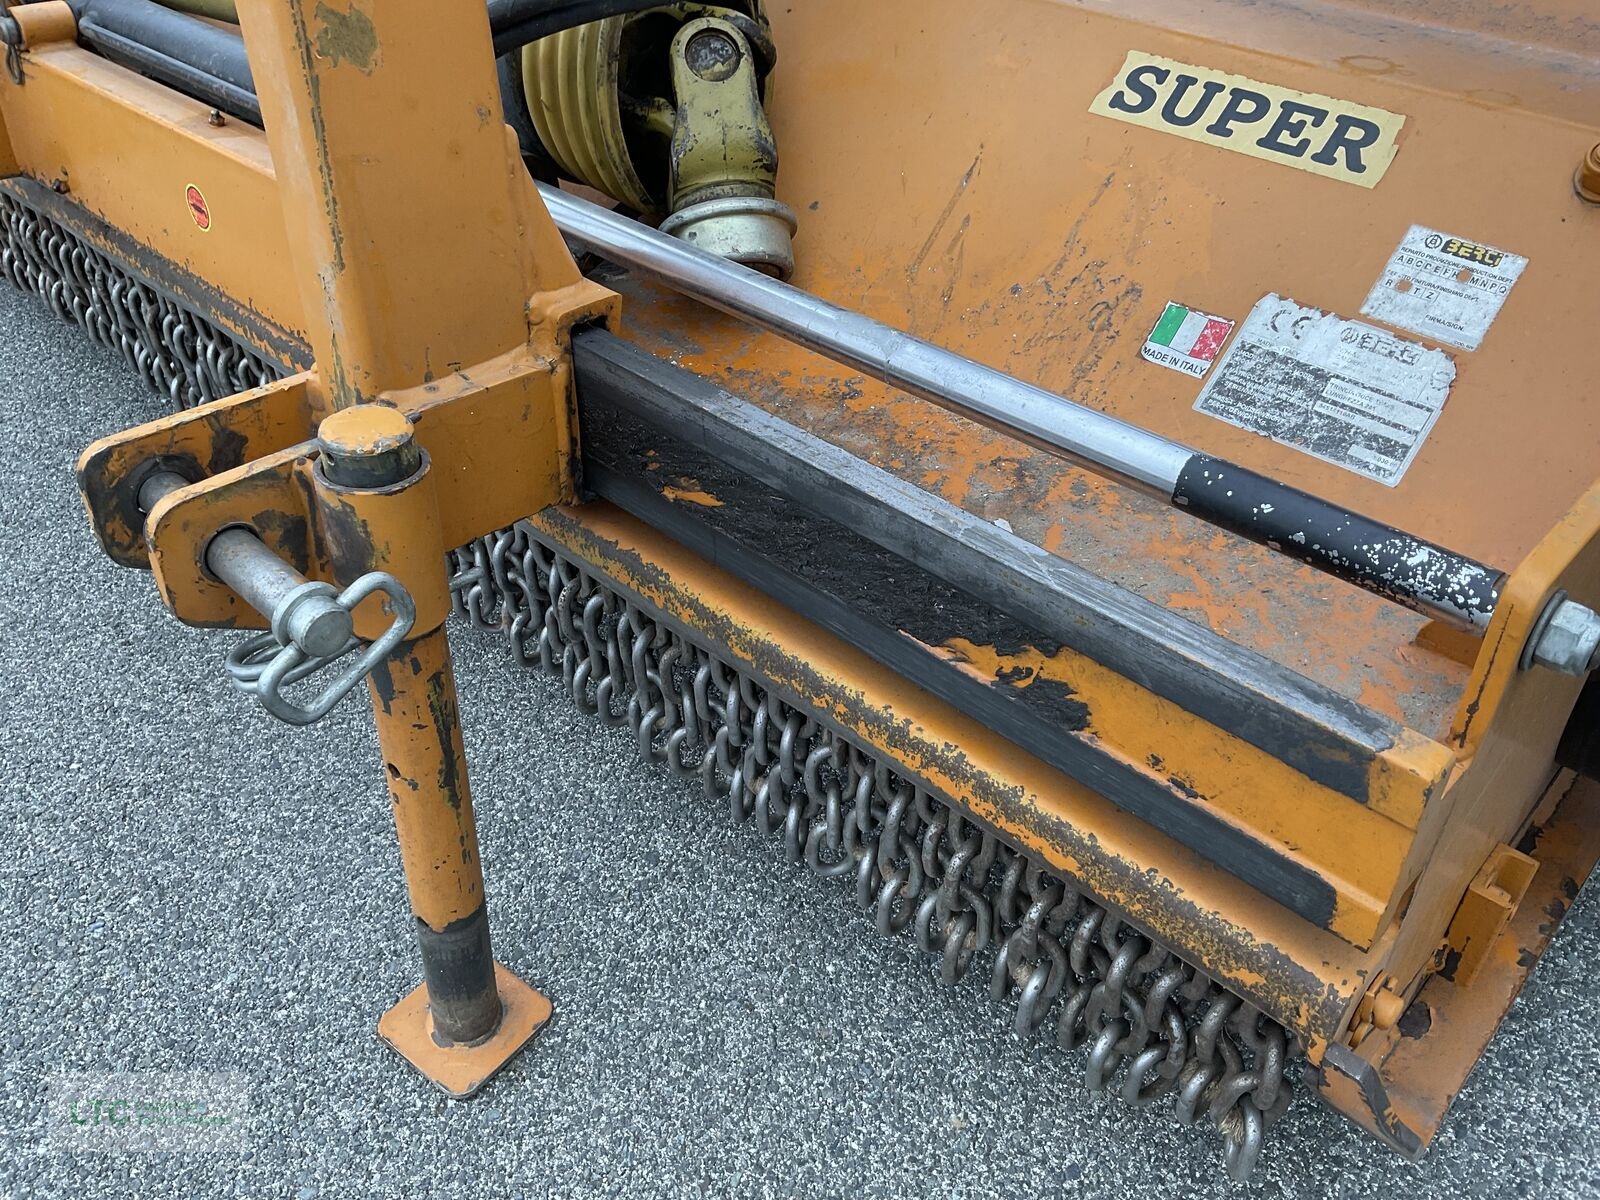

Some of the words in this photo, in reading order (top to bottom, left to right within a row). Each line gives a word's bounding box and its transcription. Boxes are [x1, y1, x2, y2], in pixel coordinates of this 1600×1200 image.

[1108, 65, 1381, 174] SUPER
[1143, 346, 1169, 363] MADE
[1168, 356, 1180, 367] IN
[1179, 360, 1207, 376] ITALY
